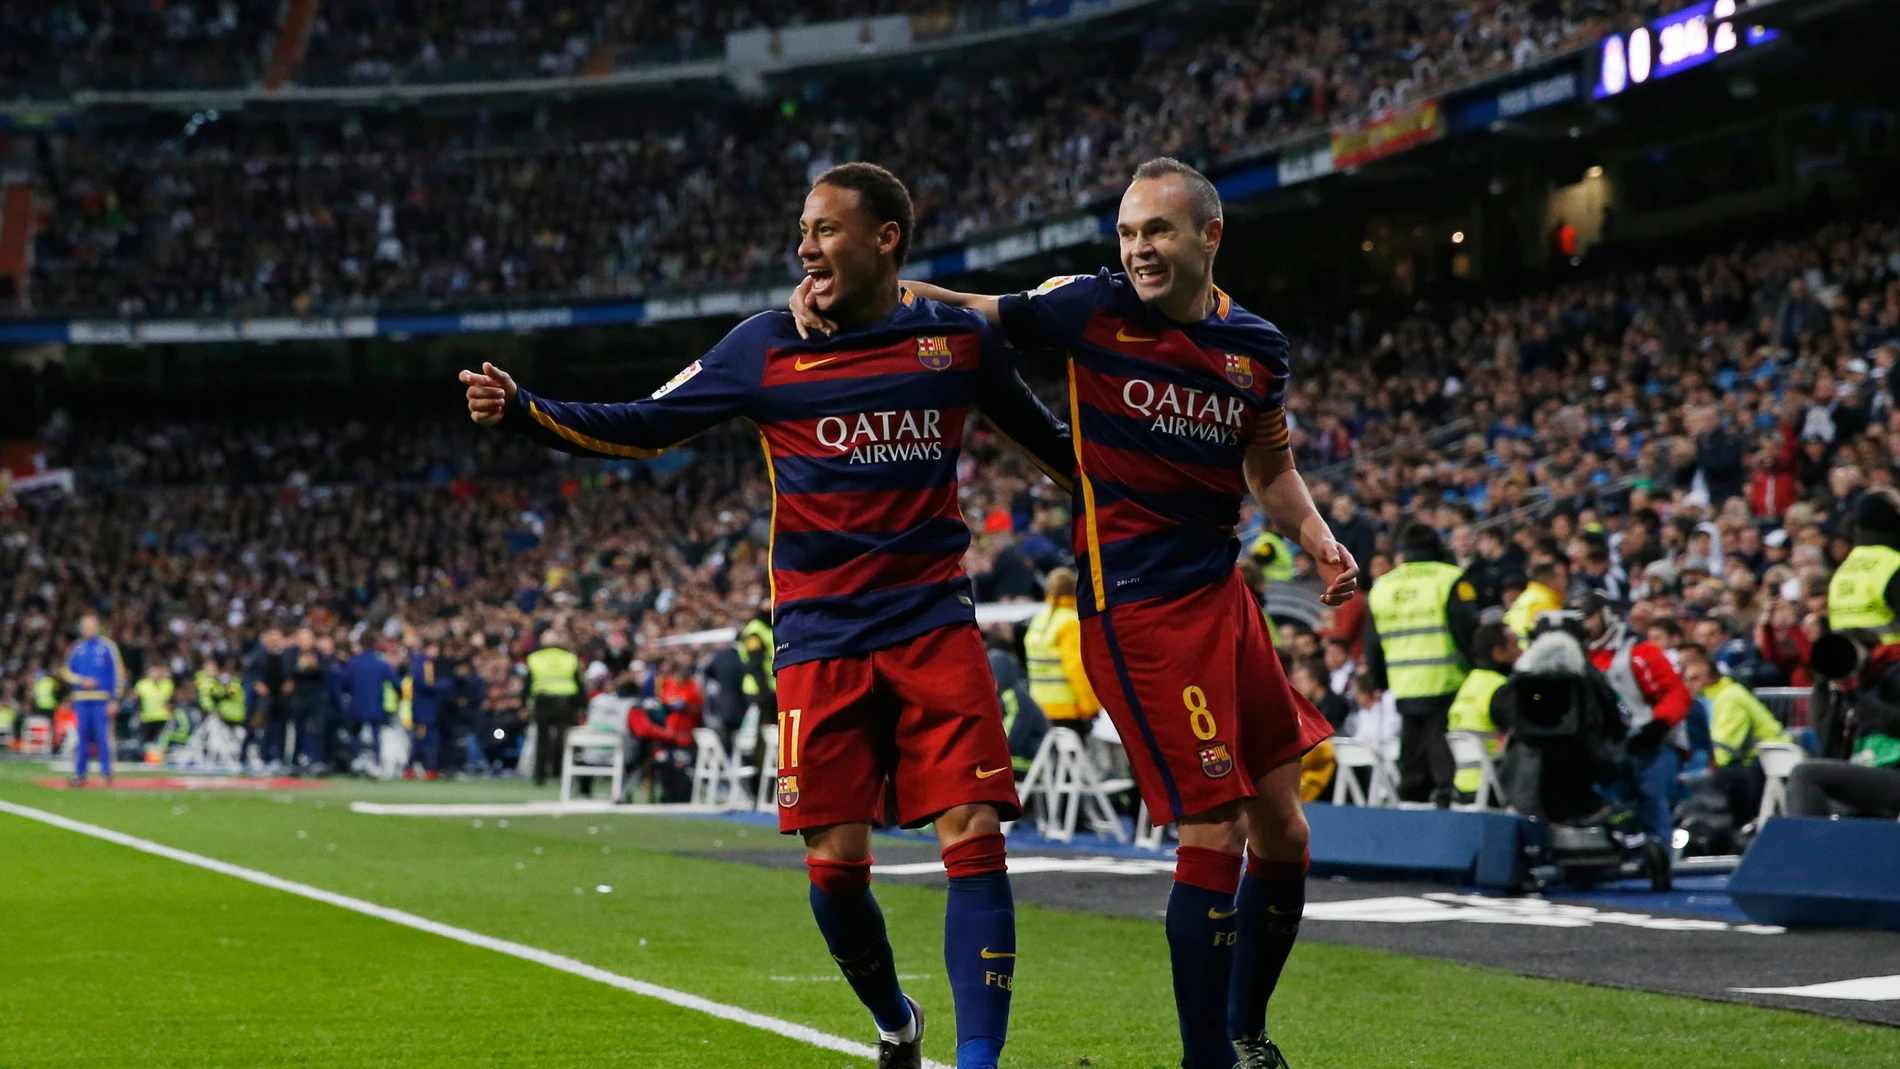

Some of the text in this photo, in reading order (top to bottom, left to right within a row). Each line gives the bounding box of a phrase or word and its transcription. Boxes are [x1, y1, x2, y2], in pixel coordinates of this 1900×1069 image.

[1123, 379, 1245, 427] QATAR
[816, 409, 942, 452] QATAR
[1150, 414, 1241, 446] AIRWAYS
[849, 442, 942, 464] AIRWAYS
[1183, 685, 1217, 741] 8
[778, 709, 801, 770] 11
